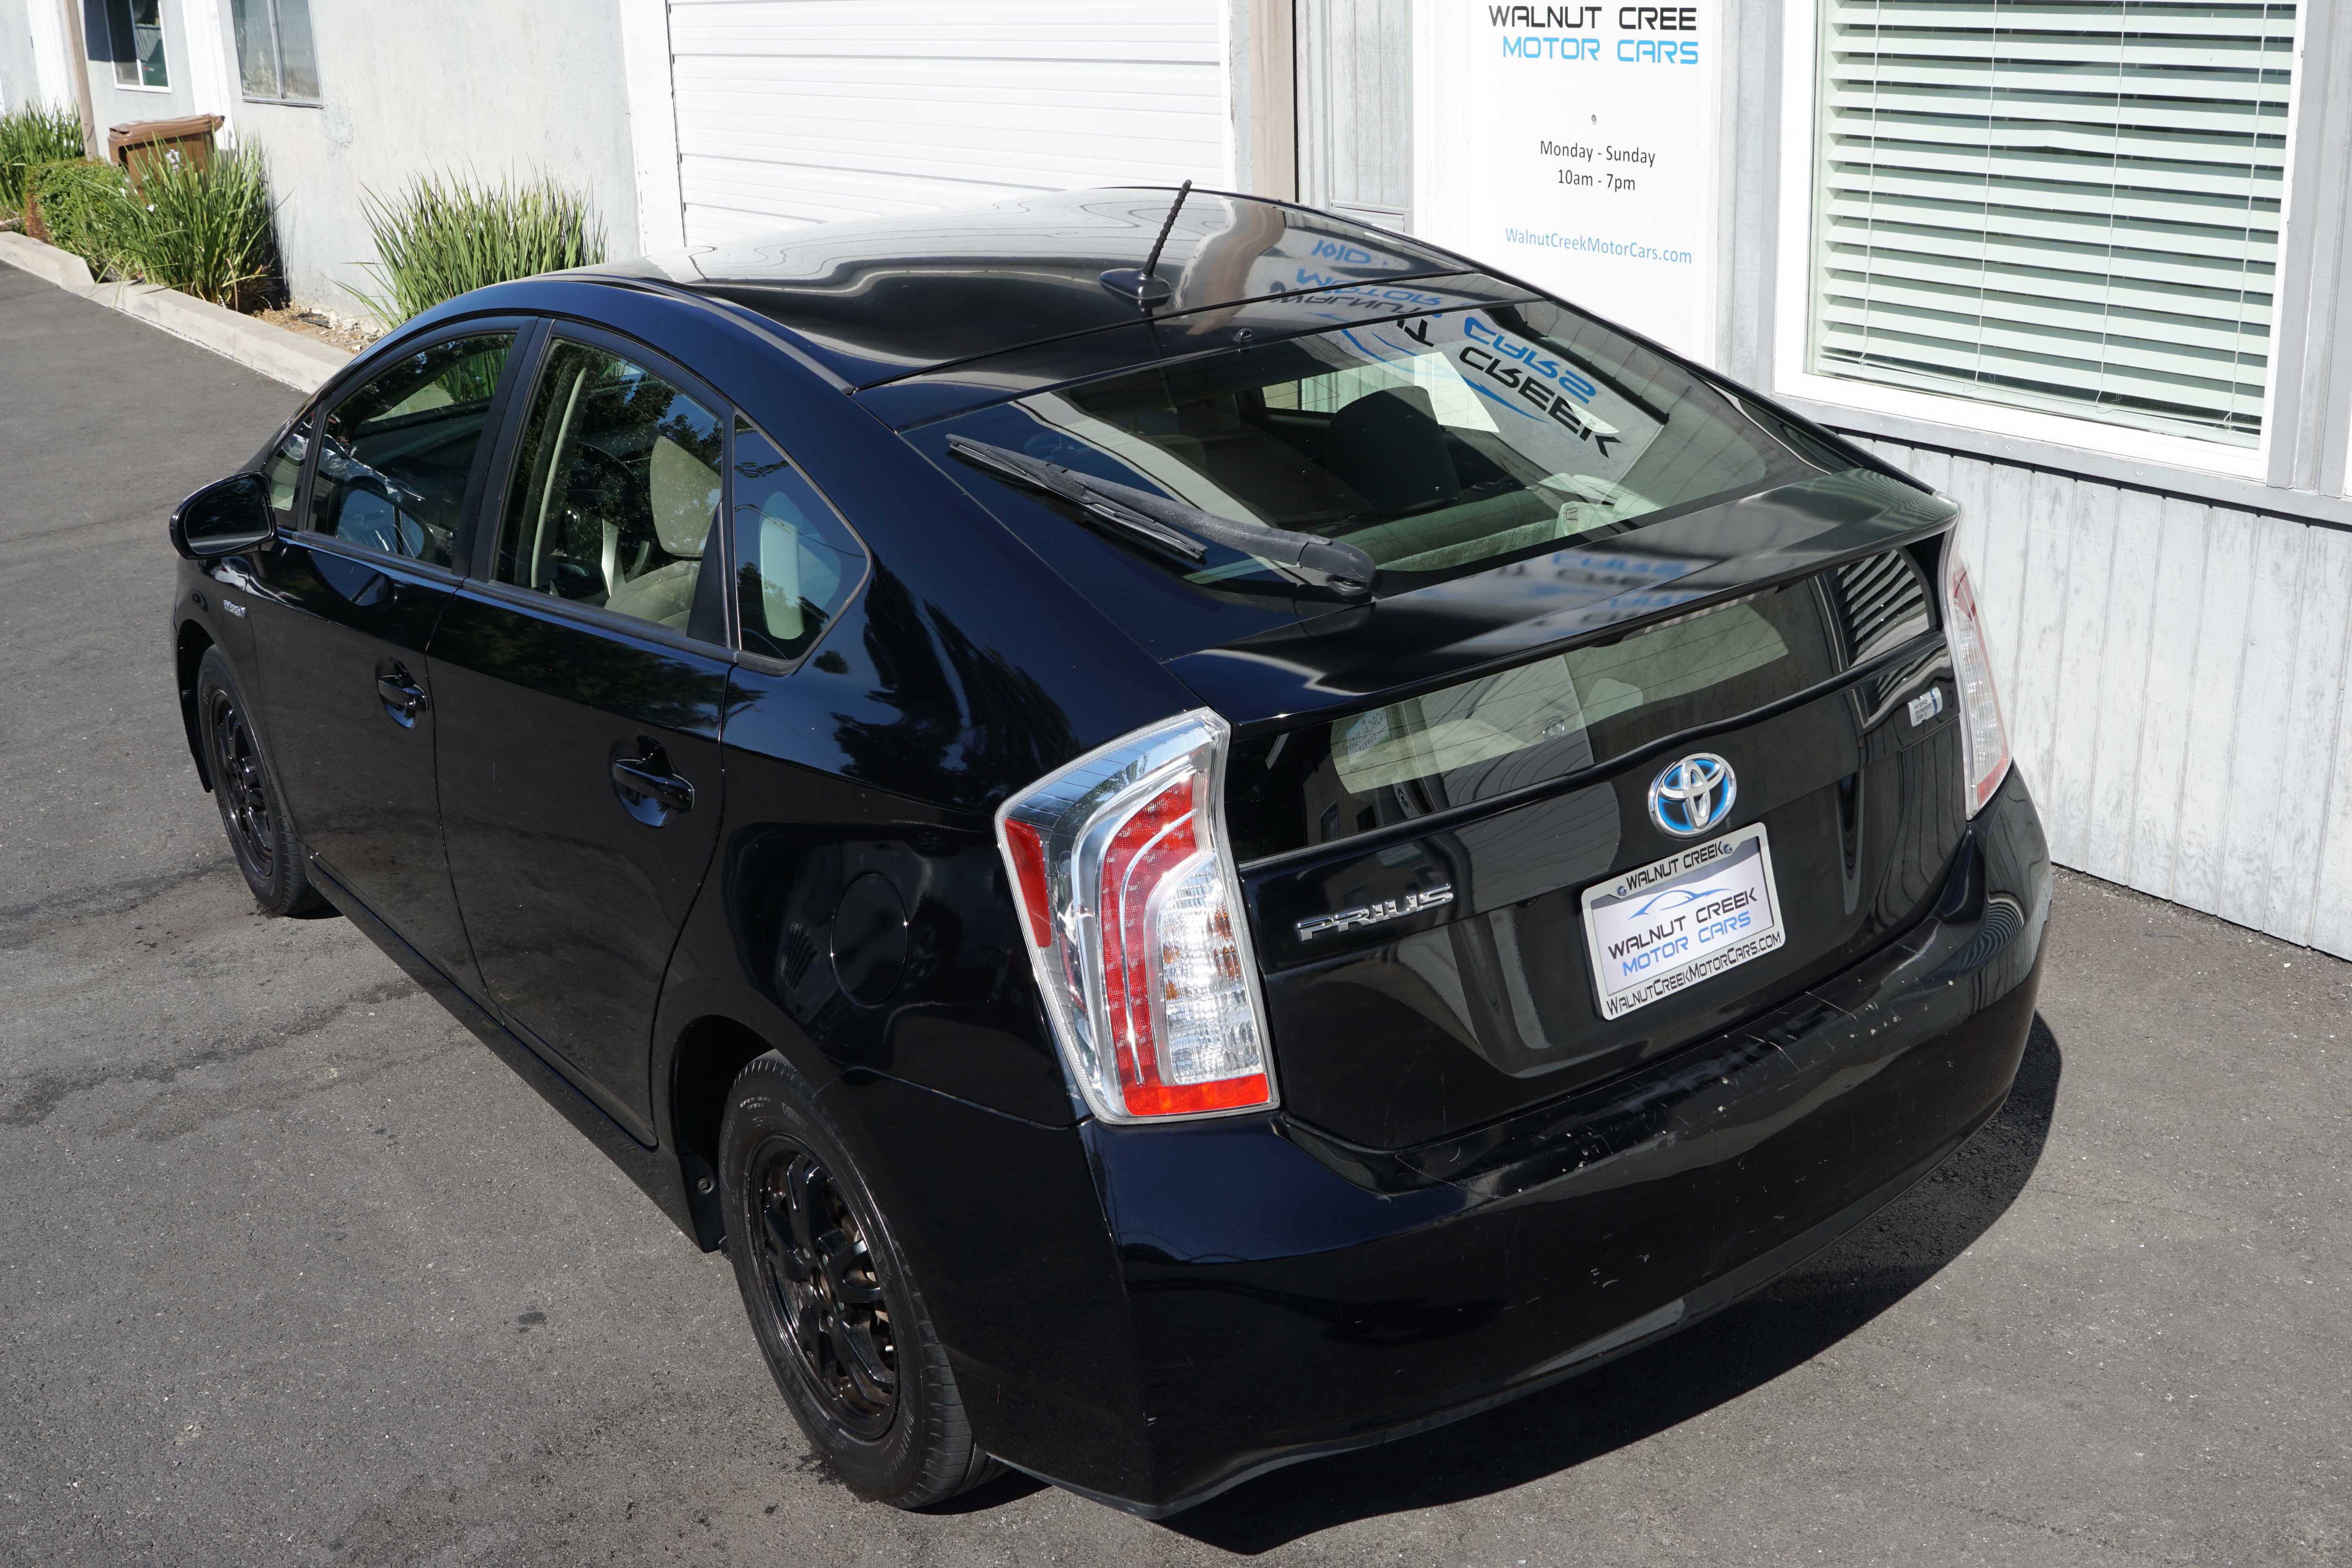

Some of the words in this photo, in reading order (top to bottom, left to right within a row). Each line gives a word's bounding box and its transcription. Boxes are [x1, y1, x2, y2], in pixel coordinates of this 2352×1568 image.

[1488, 5, 1602, 29] WALNUT
[1619, 7, 1697, 31] CREE
[1503, 36, 1600, 61] MOTOR
[1617, 39, 1699, 65] CARS
[1540, 140, 1593, 163] Monday
[1606, 145, 1655, 168] Sunday
[1558, 169, 1593, 187] 10am
[1606, 173, 1636, 193] 7pm
[1506, 227, 1692, 264] WalnutCreekMotorCars.com
[1914, 699, 1928, 710] HYBRID
[1626, 858, 1679, 890] WALNUT
[1683, 841, 1724, 869] CREEK
[1296, 883, 1454, 941] PRIUS
[1608, 915, 1686, 960] WALNUT
[1696, 887, 1757, 923] CREEK
[1622, 936, 1688, 976] MOTOR
[1698, 911, 1751, 943] CARS
